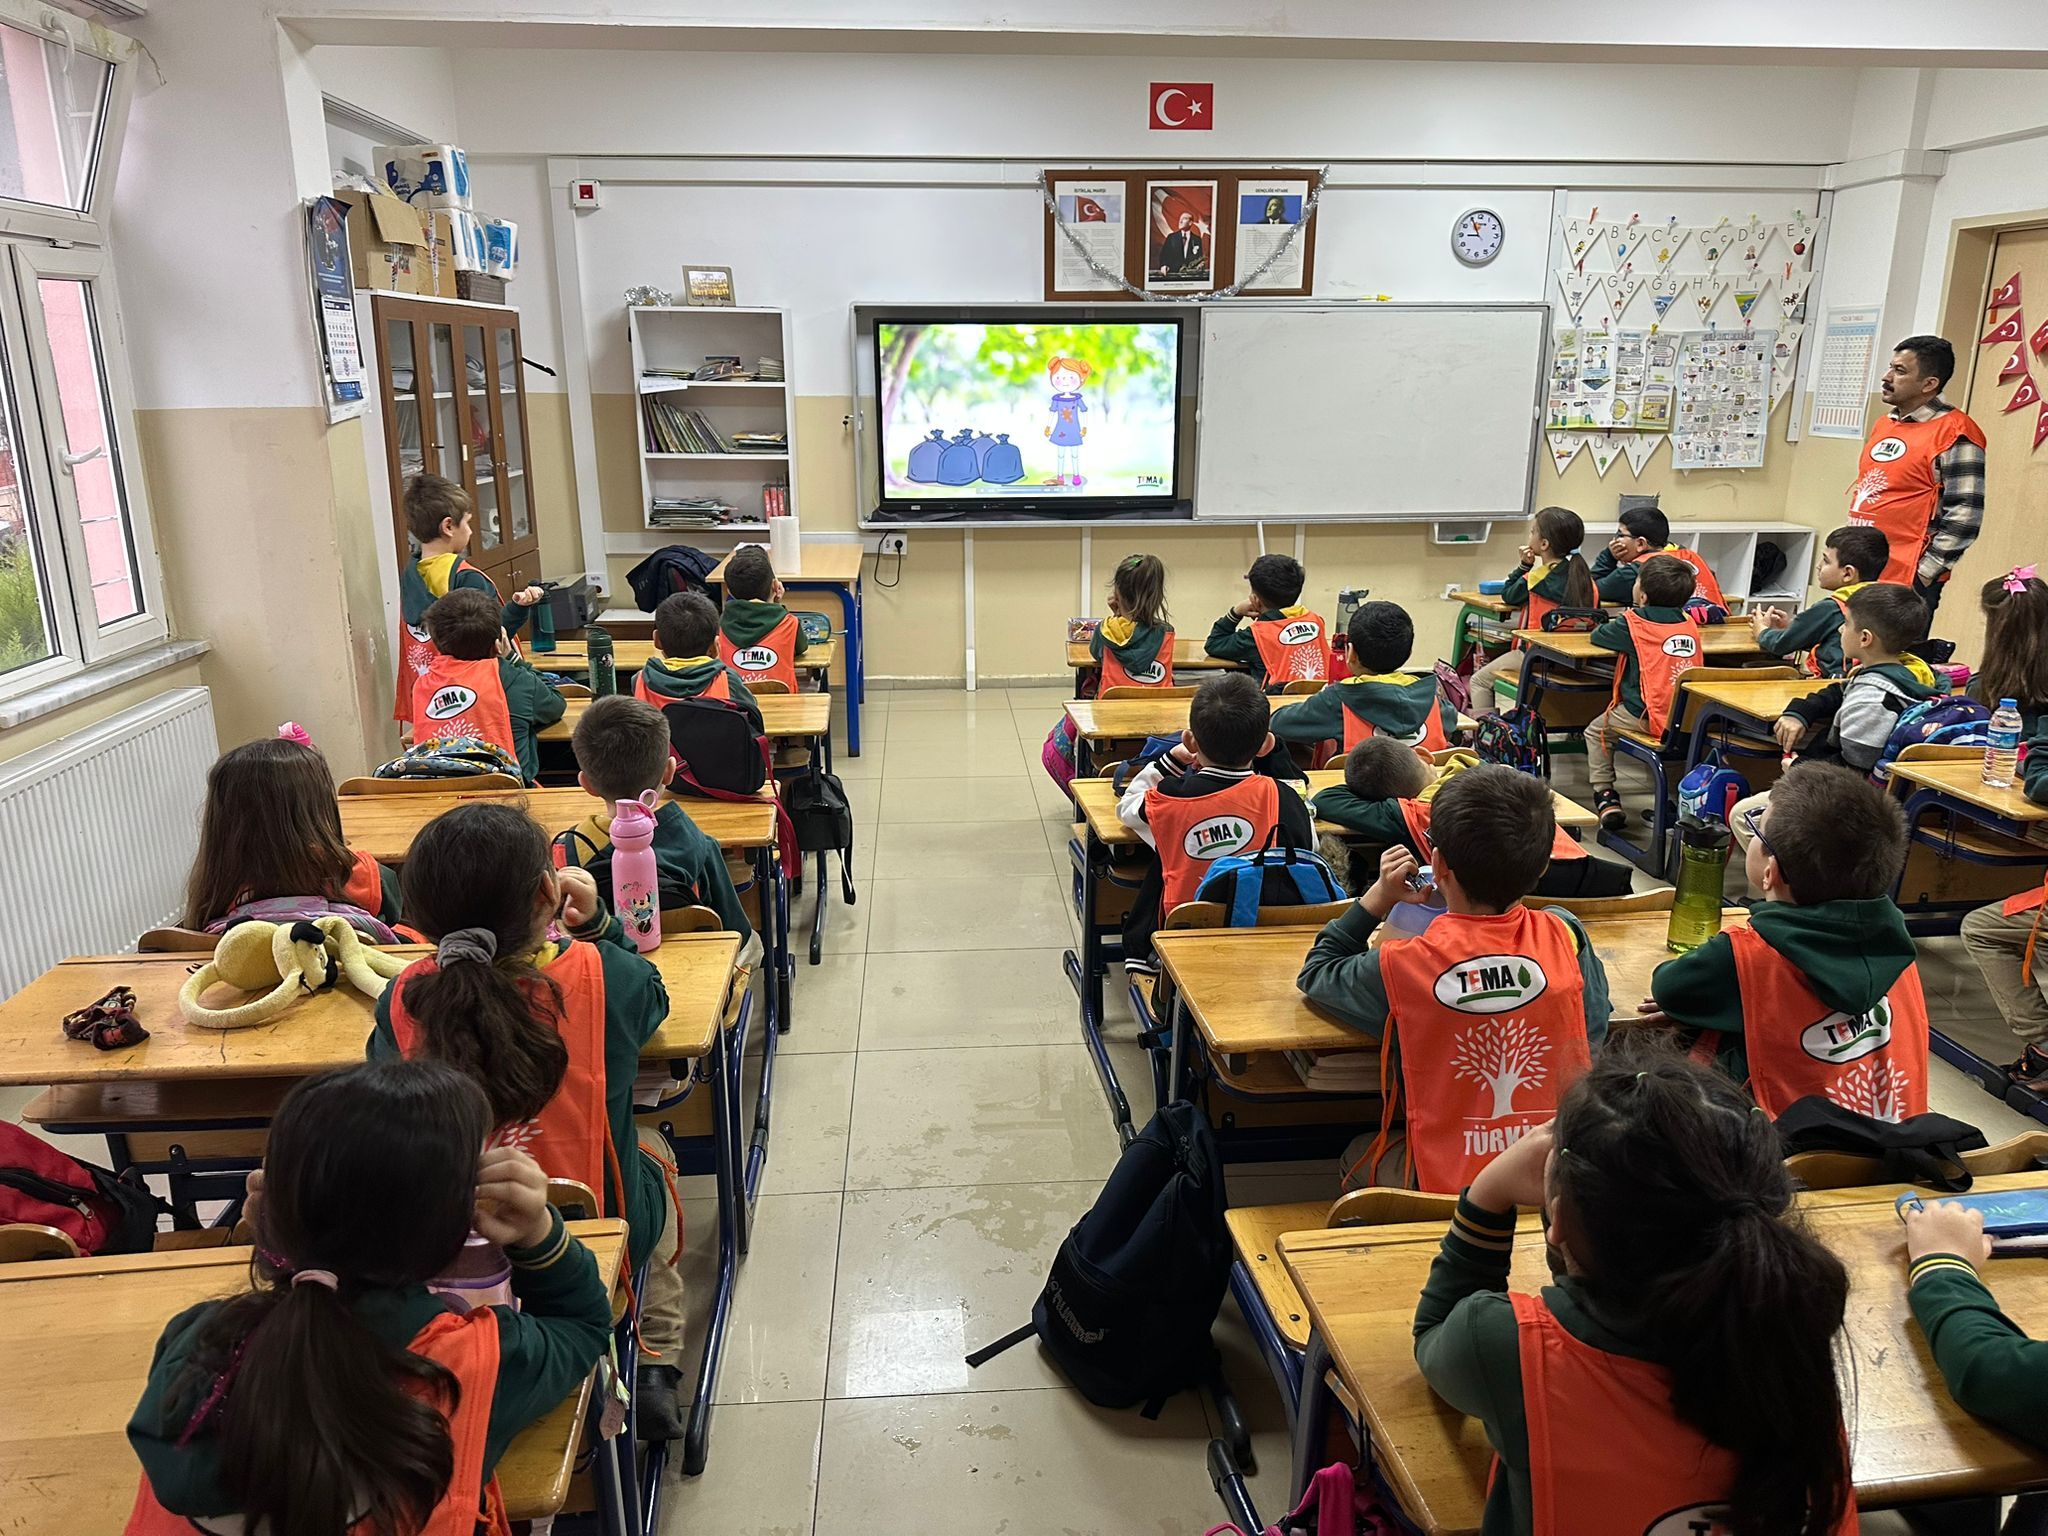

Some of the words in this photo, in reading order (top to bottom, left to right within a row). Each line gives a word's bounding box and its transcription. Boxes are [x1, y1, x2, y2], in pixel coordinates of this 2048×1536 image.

[1286, 624, 1310, 637] TEMA
[742, 651, 765, 660] TEMA
[434, 691, 459, 710] TEMA
[1194, 823, 1233, 848] TEMA
[1456, 964, 1515, 993] TEMA
